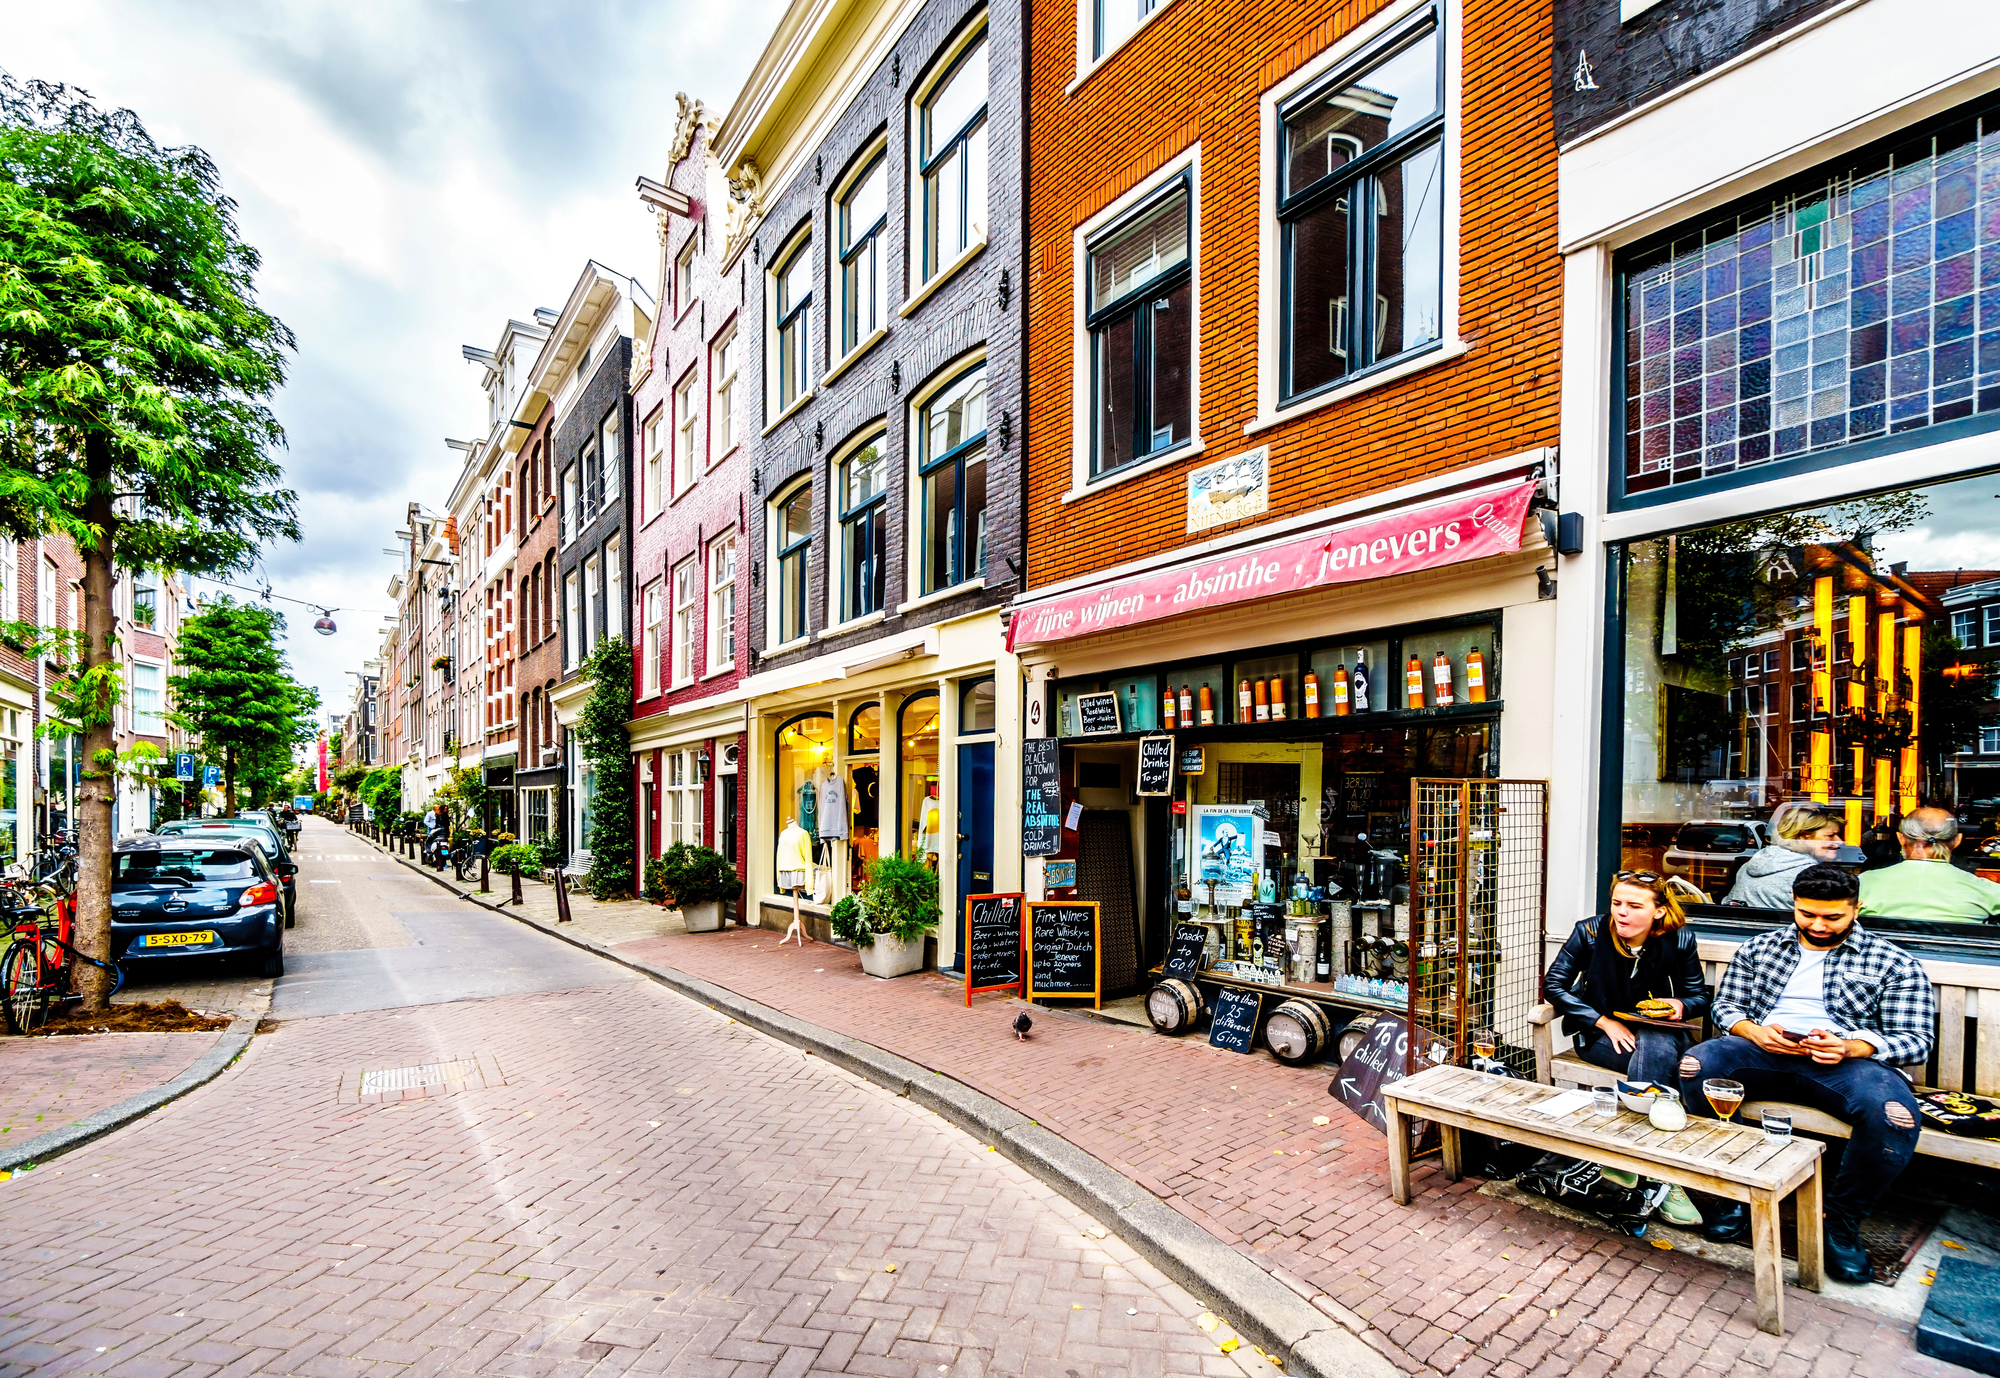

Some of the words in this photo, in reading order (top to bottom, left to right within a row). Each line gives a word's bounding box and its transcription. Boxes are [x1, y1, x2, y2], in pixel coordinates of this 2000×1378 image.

[1469, 502, 1520, 545] Quinta
[1034, 607, 1074, 638] fijne
[1080, 593, 1145, 627] wijnen
[1173, 555, 1280, 604] absinthe
[1316, 521, 1461, 581] jenevers
[1031, 701, 1039, 722] 4
[1025, 742, 1036, 753] THE
[1038, 739, 1054, 751] BEST
[1143, 742, 1170, 756] Chilled
[181, 756, 190, 767] P
[1025, 752, 1046, 765] PLACE
[1143, 757, 1169, 768] Drinks
[208, 768, 217, 777] P
[1025, 765, 1032, 775] IN
[1034, 762, 1054, 775] TOWN
[1025, 776, 1038, 787] FOR
[1142, 771, 1151, 782] To
[1025, 789, 1041, 800] THE
[1025, 801, 1047, 814] REAL
[1024, 814, 1060, 827] ABSINTHE
[1024, 831, 1044, 841] COLD
[1024, 841, 1051, 851] DRINKS
[1035, 909, 1056, 924] Fine
[1059, 909, 1089, 922] Wines
[150, 932, 208, 945] 5-SXD-79
[1034, 926, 1054, 938] Rare
[1056, 926, 1090, 938] Whiskys
[1177, 927, 1205, 942] Snacks
[1034, 942, 1064, 953] Original
[1066, 942, 1092, 951] Dutch
[1177, 945, 1192, 956] to
[1049, 951, 1080, 961] Jenever
[1156, 991, 1177, 1007] NAPA
[1220, 990, 1241, 1001] more
[1240, 993, 1258, 1007] than
[1151, 1001, 1178, 1018] VALLEY
[1226, 1004, 1244, 1019] 25
[1215, 1015, 1251, 1033] different
[1216, 1030, 1243, 1047] Gins
[1268, 1025, 1306, 1041] Bordeaux
[1374, 1021, 1398, 1046] To
[1354, 1043, 1388, 1073] chilled
